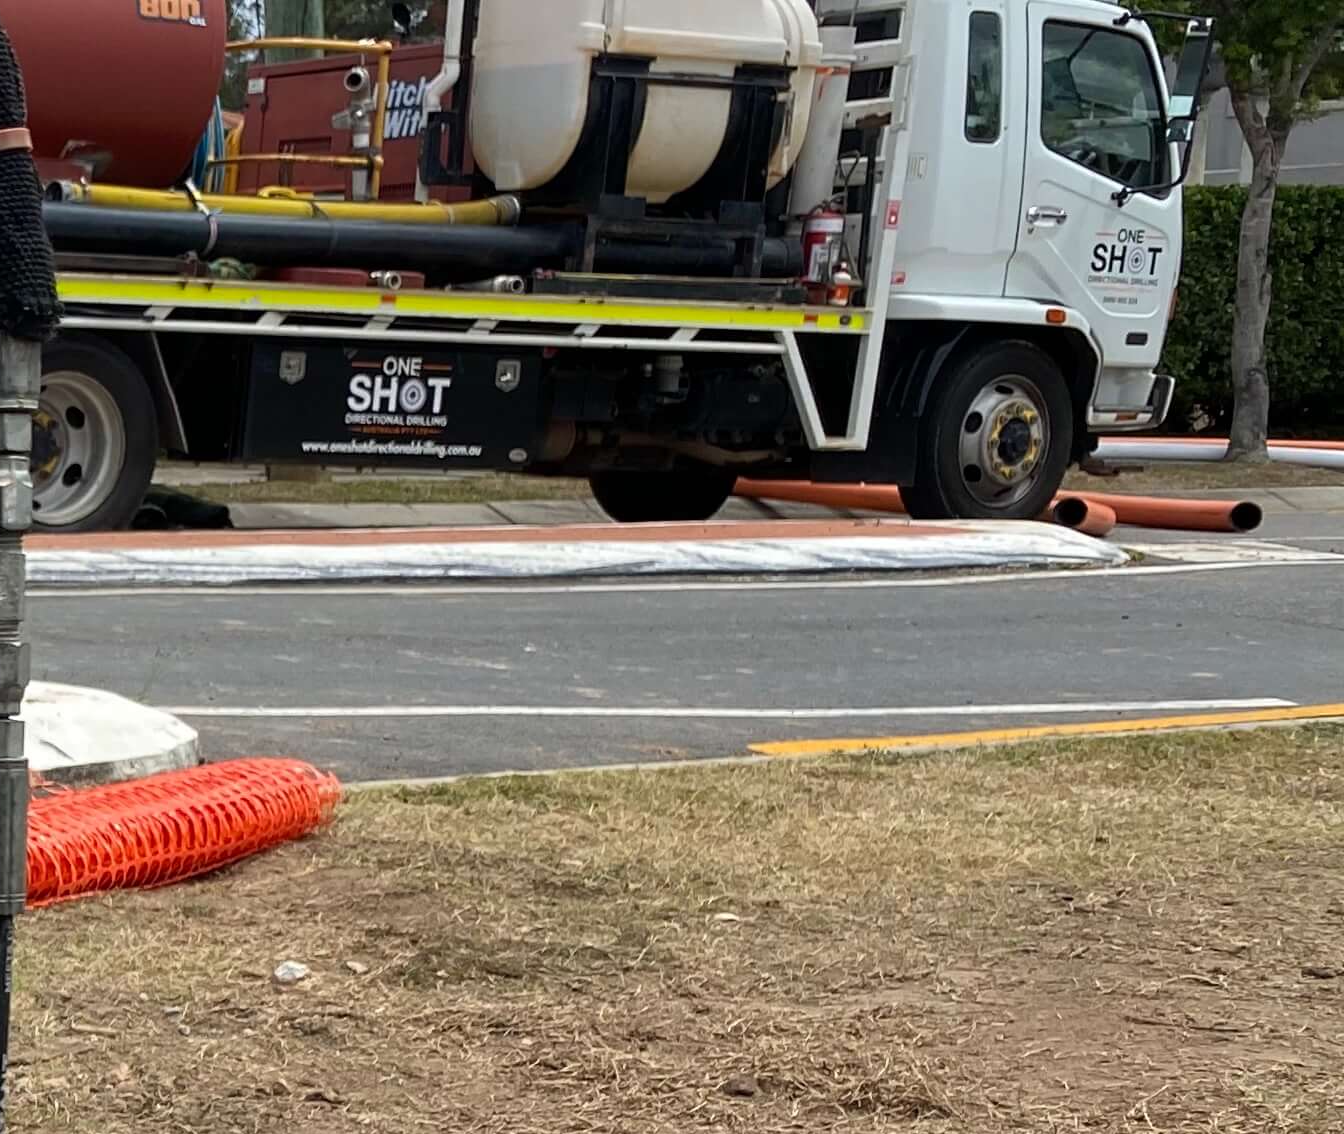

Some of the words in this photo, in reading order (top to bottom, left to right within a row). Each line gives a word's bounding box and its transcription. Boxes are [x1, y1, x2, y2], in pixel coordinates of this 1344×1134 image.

[383, 110, 423, 139] Wit
[1117, 228, 1145, 244] ONE
[1090, 243, 1162, 275] SHOT
[383, 356, 423, 376] ONE
[347, 373, 451, 414] SHOT
[345, 413, 405, 426] DIRECTIONAL
[406, 415, 448, 428] DRILLING
[301, 438, 482, 459] www.oneshotdirectionaldrilling.com.au
